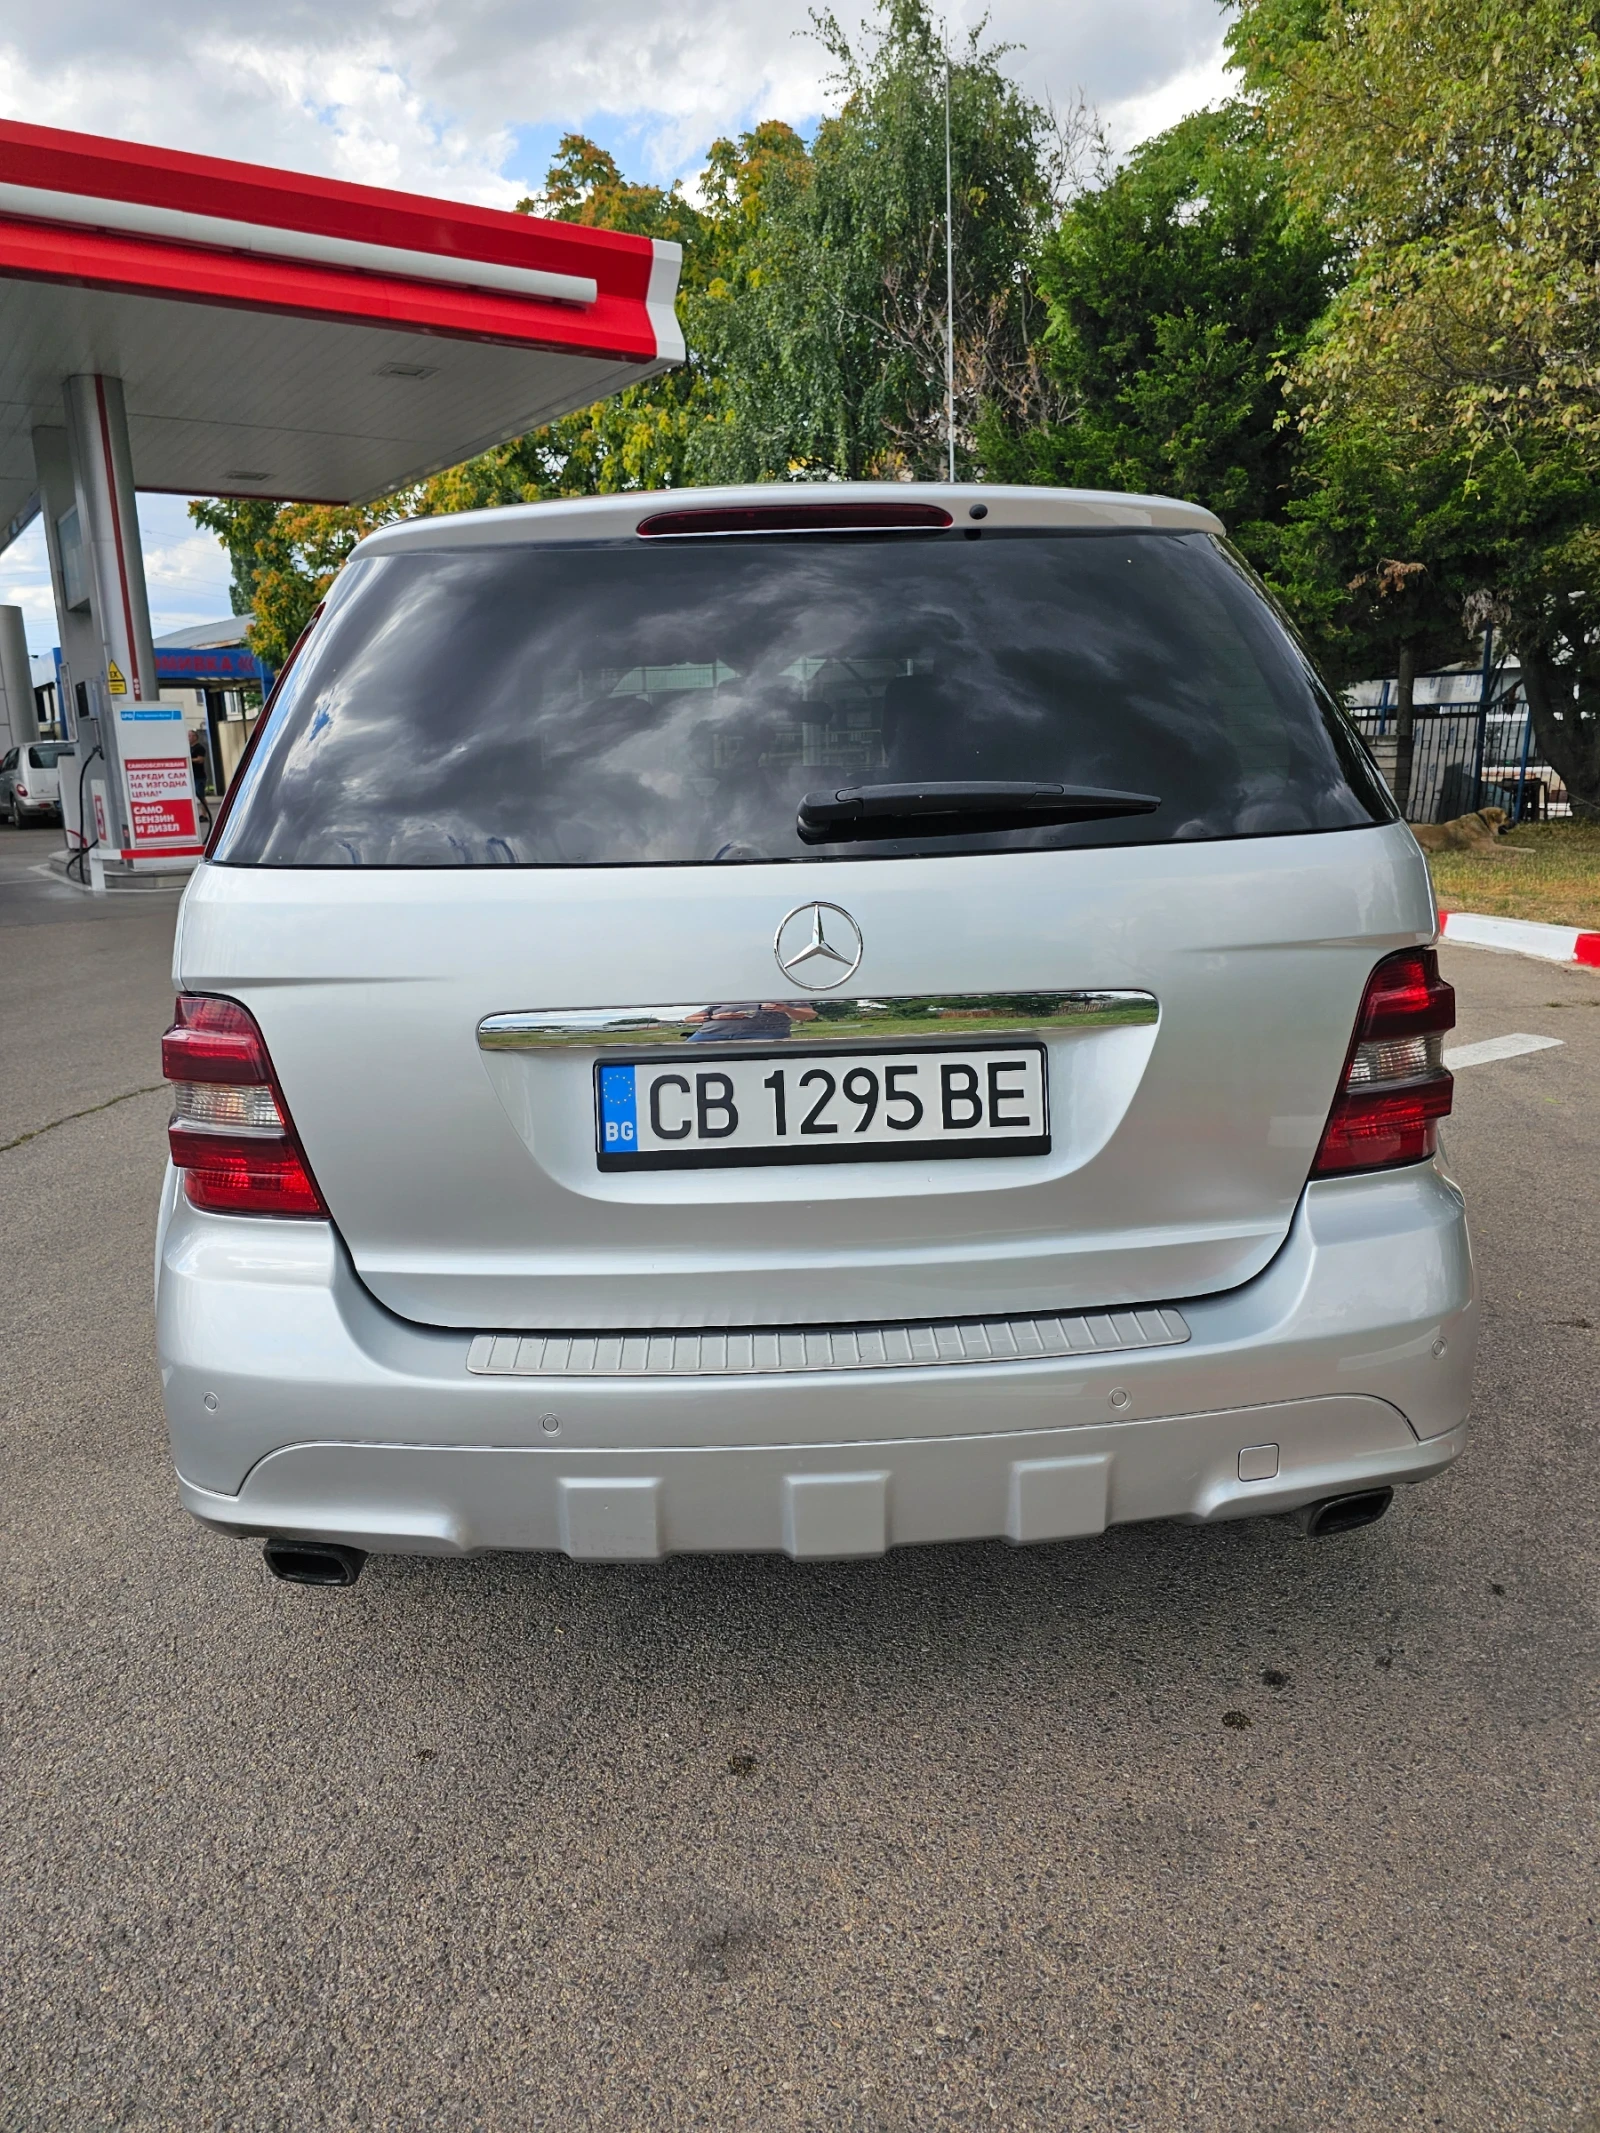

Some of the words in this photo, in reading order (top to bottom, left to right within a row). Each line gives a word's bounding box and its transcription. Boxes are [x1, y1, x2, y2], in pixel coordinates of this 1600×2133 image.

[146, 780, 187, 788] ИЗГОДНА
[133, 805, 164, 815] САМО
[135, 814, 174, 824] БЕНЗИН
[136, 825, 145, 833] И
[147, 823, 180, 834] ДИЗЕЛ
[649, 1072, 739, 1140] CB
[763, 1065, 924, 1136] 1295
[940, 1061, 1030, 1131] BE
[605, 1121, 634, 1142] BG
